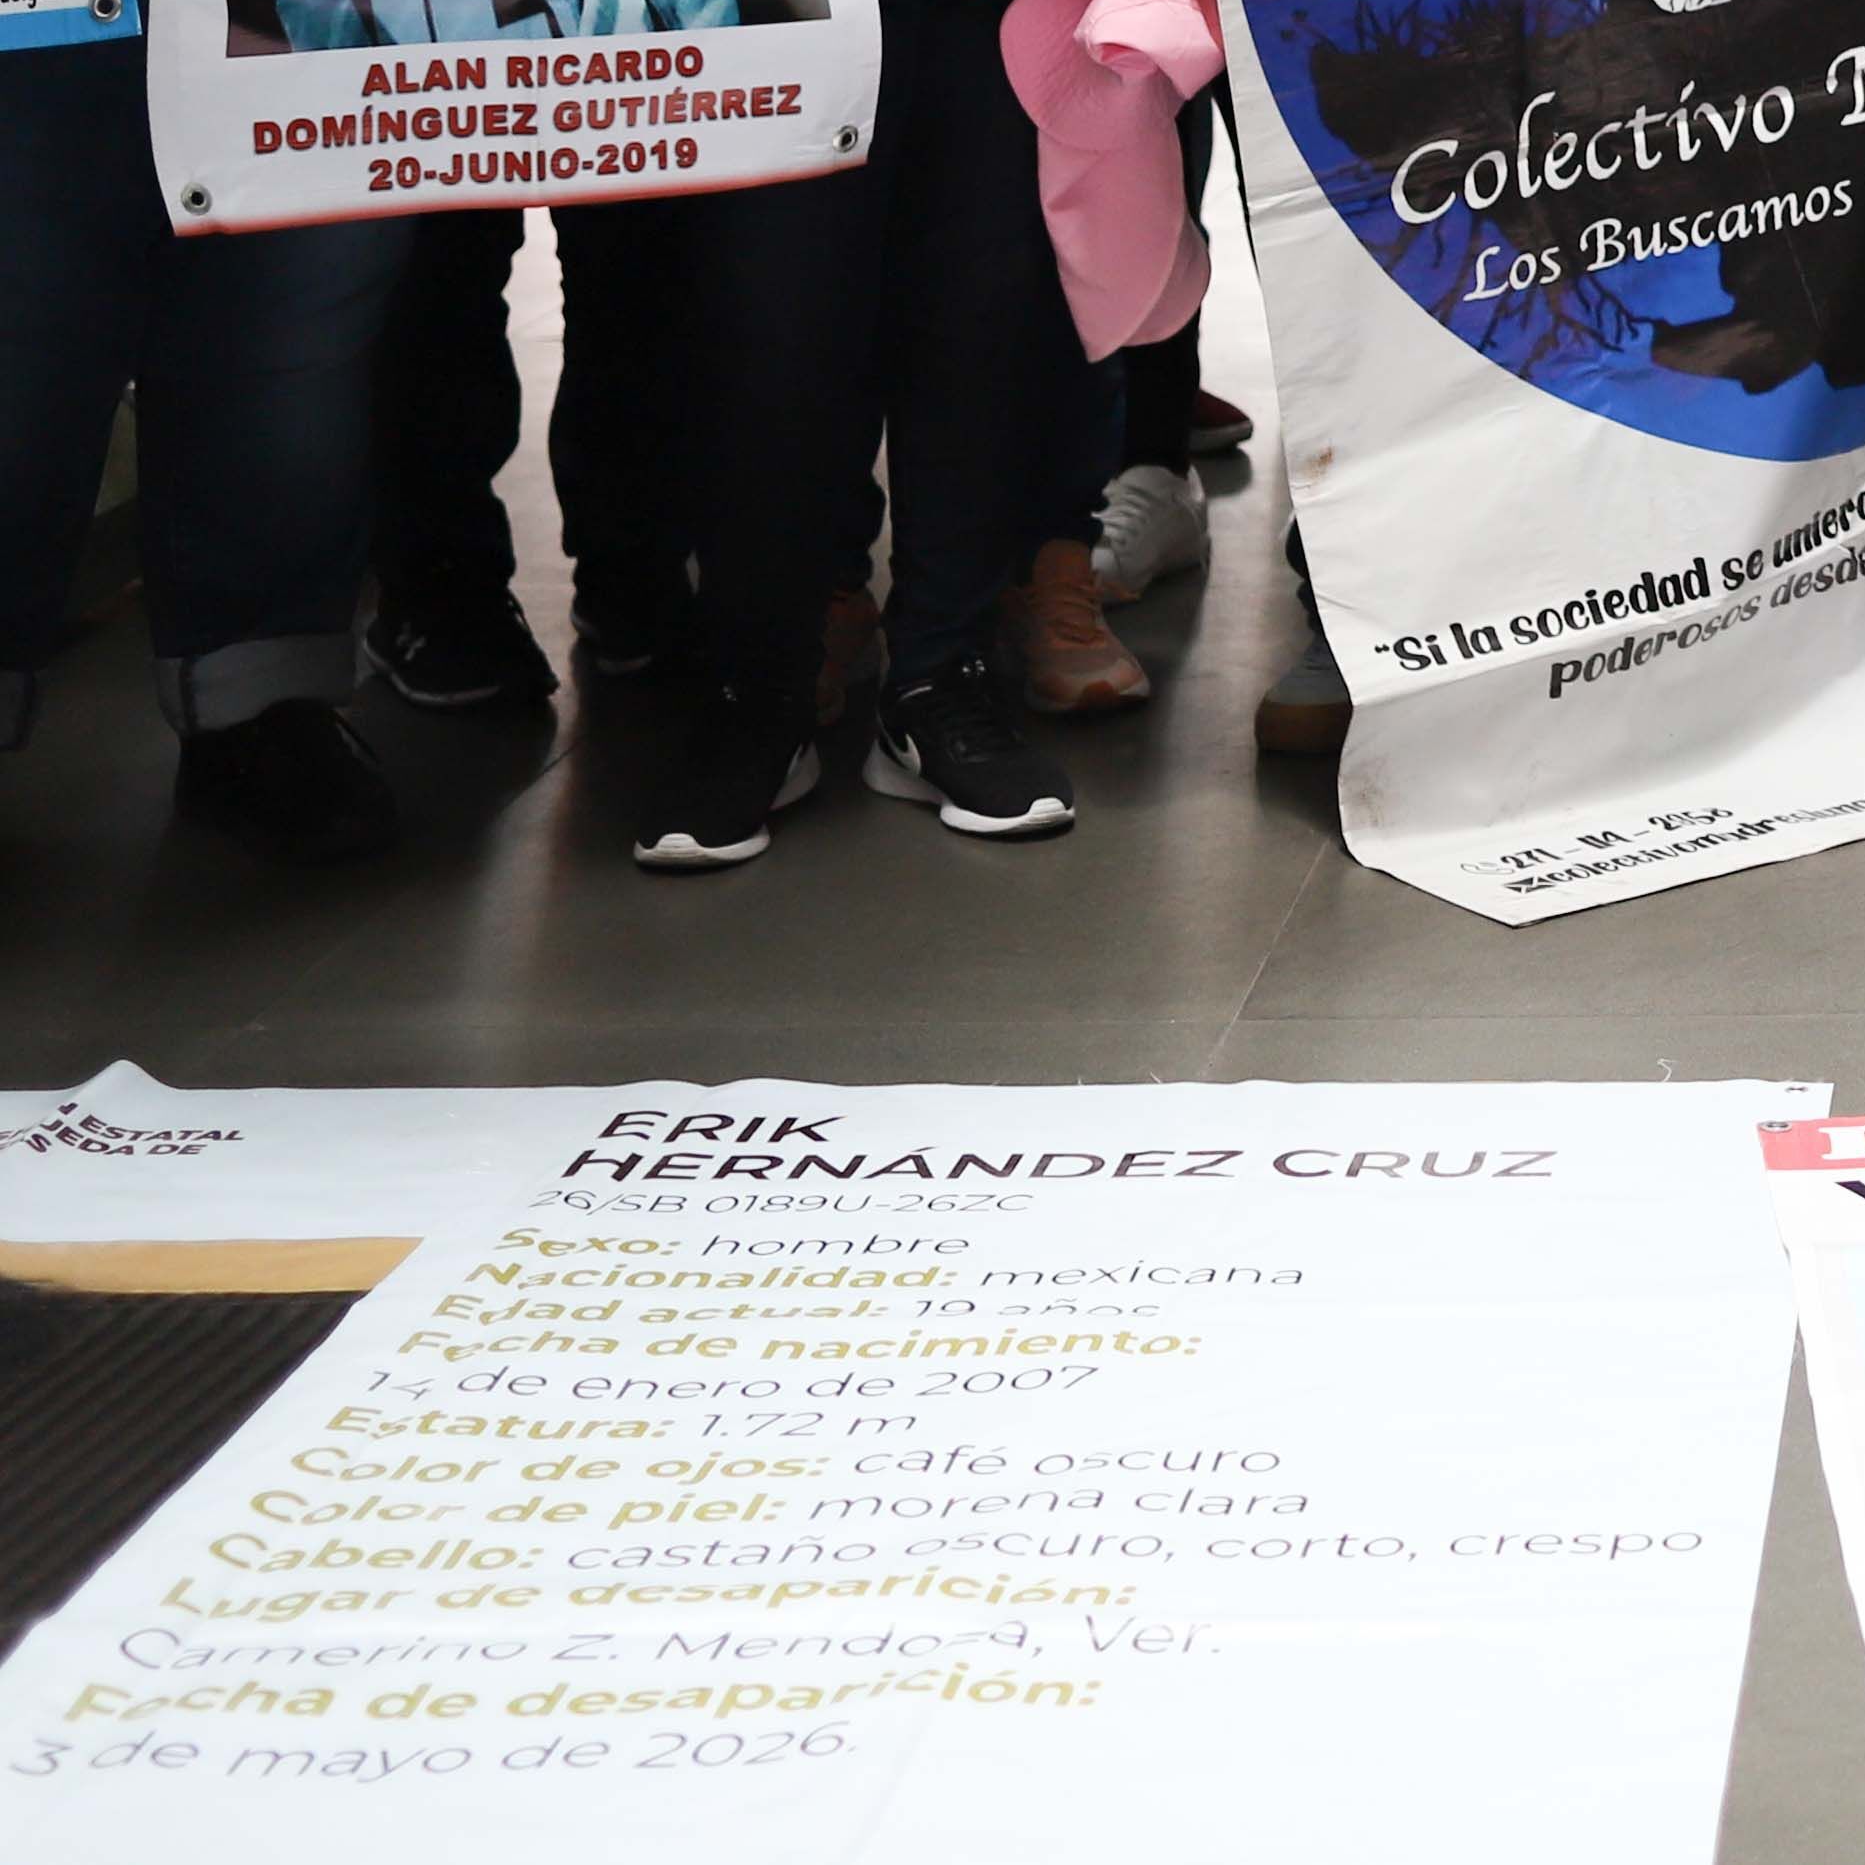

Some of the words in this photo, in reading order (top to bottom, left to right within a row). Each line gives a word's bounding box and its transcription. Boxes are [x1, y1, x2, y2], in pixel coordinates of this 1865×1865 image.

[362, 57, 487, 97] ALAN
[507, 45, 704, 88] RICARDO
[253, 103, 538, 154] DOMÍNGUEZ
[553, 84, 802, 132] GUTIÉRREZ
[368, 137, 699, 191] 20-JUNIO-2019
[1390, 80, 1795, 225] Colectivo
[1463, 245, 1562, 302] Los
[1579, 179, 1853, 272] Buscamos
[1449, 622, 1502, 659] la
[1509, 557, 1711, 645] sociedad
[1722, 549, 1764, 592] se
[1548, 591, 1761, 699] poderosos
[598, 1110, 847, 1144] ERIK
[560, 1146, 1242, 1182] HERNÁNDEZ
[1270, 1148, 1559, 1181] CRUZ
[494, 1227, 682, 1258] Sexo:
[700, 1234, 971, 1257] hombre
[467, 1261, 960, 1292] Nacionalidad:
[979, 1259, 1305, 1289] mexicana
[326, 1405, 676, 1440] Estatura:
[700, 1412, 826, 1438] 1.72
[90, 1729, 203, 1772] de
[225, 1737, 473, 1785] mayo
[501, 1736, 612, 1772] de
[634, 1720, 858, 1771] 2026.
